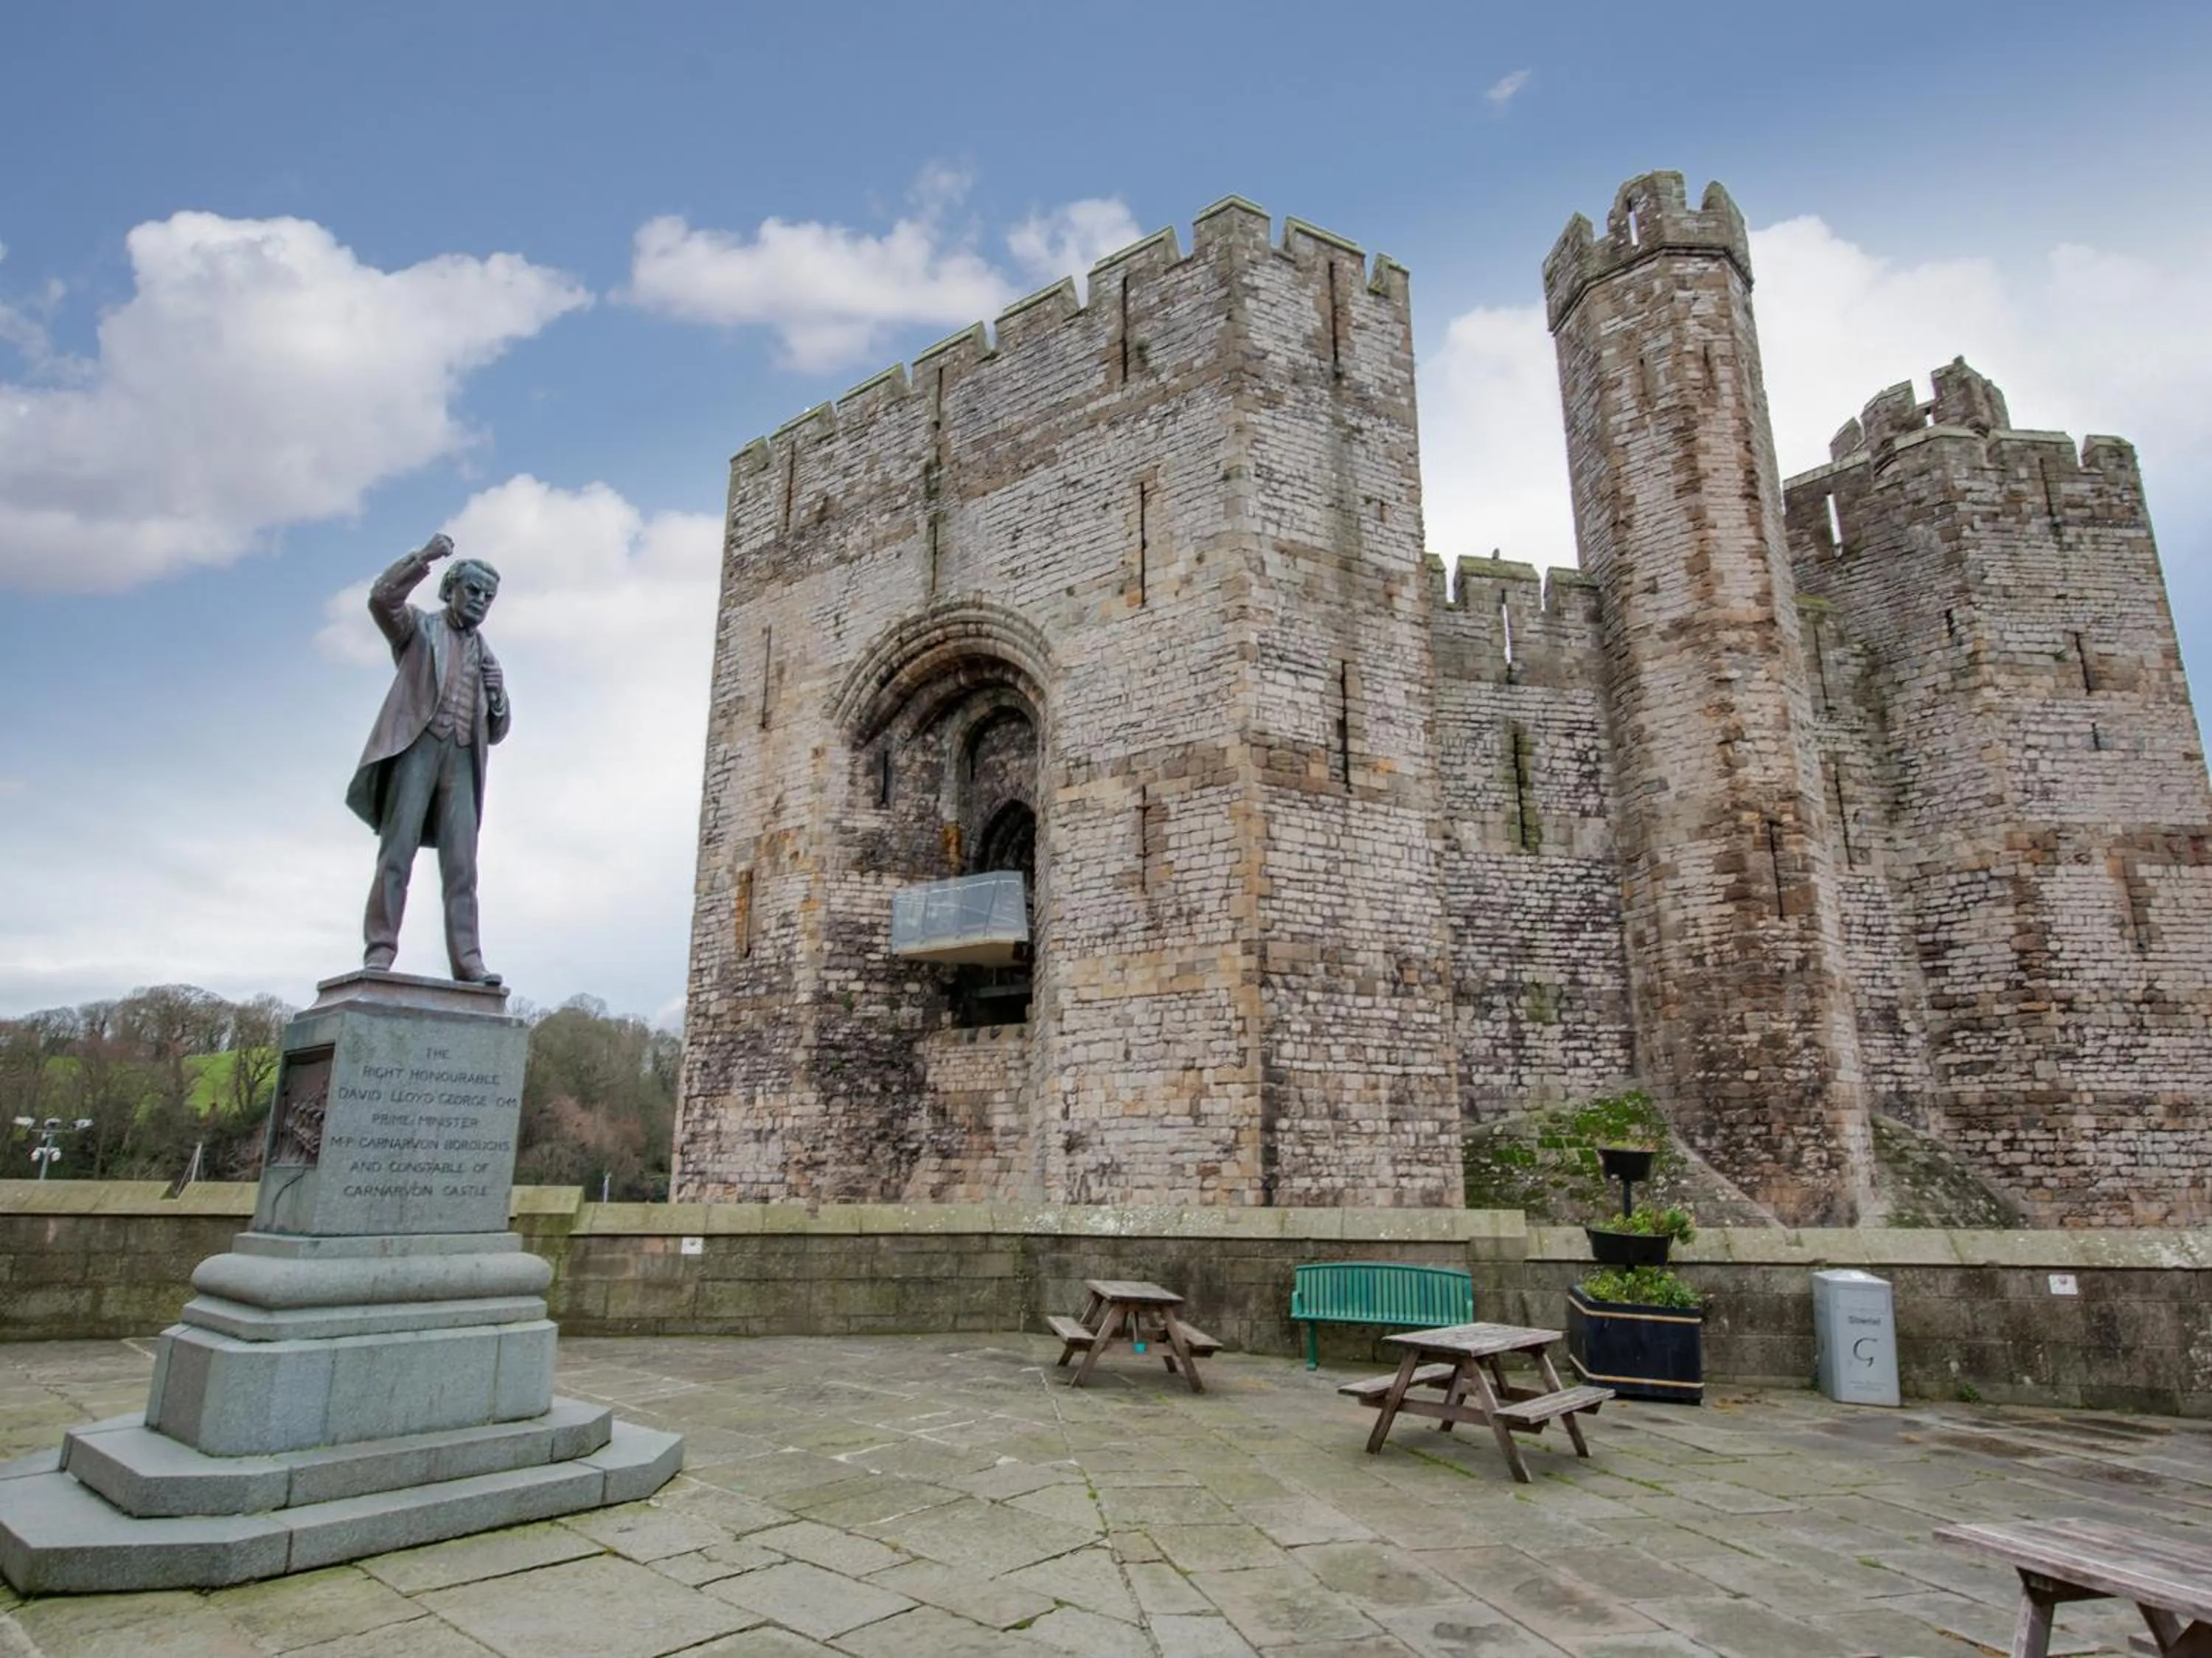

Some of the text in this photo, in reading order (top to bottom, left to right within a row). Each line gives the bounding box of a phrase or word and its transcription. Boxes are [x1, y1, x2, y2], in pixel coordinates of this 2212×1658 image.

[425, 1047, 450, 1060] THE
[363, 1065, 501, 1086] RIGHT HONOURABLE
[338, 1087, 382, 1101] DAVID
[390, 1091, 434, 1105] LLOYD
[372, 1114, 479, 1128] PRIME MINISTER
[358, 1137, 439, 1151] CARNARVON
[349, 1162, 490, 1173] AND CONSTABLE OF
[343, 1185, 488, 1198] CARNARVON CASTLE
